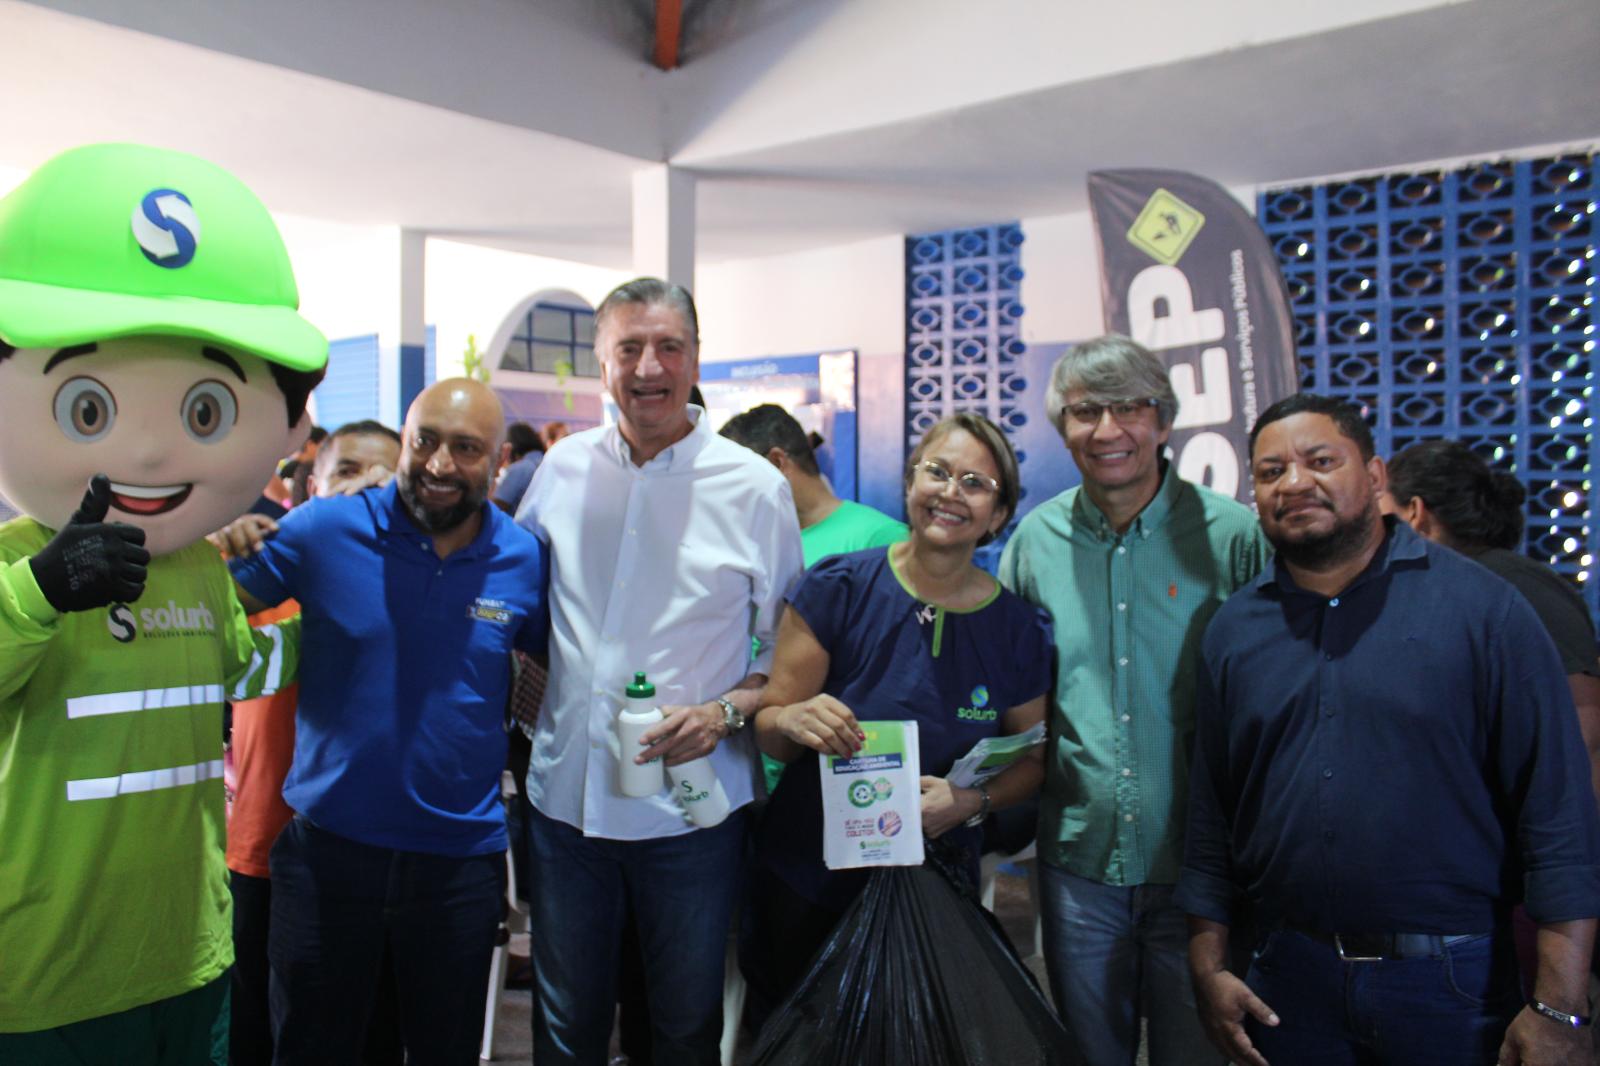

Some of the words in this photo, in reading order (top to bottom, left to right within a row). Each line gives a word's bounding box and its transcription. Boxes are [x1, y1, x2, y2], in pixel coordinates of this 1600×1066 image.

[1228, 248, 1247, 310] Públicos
[1234, 310, 1254, 370] Serviços
[957, 706, 998, 721] solurb
